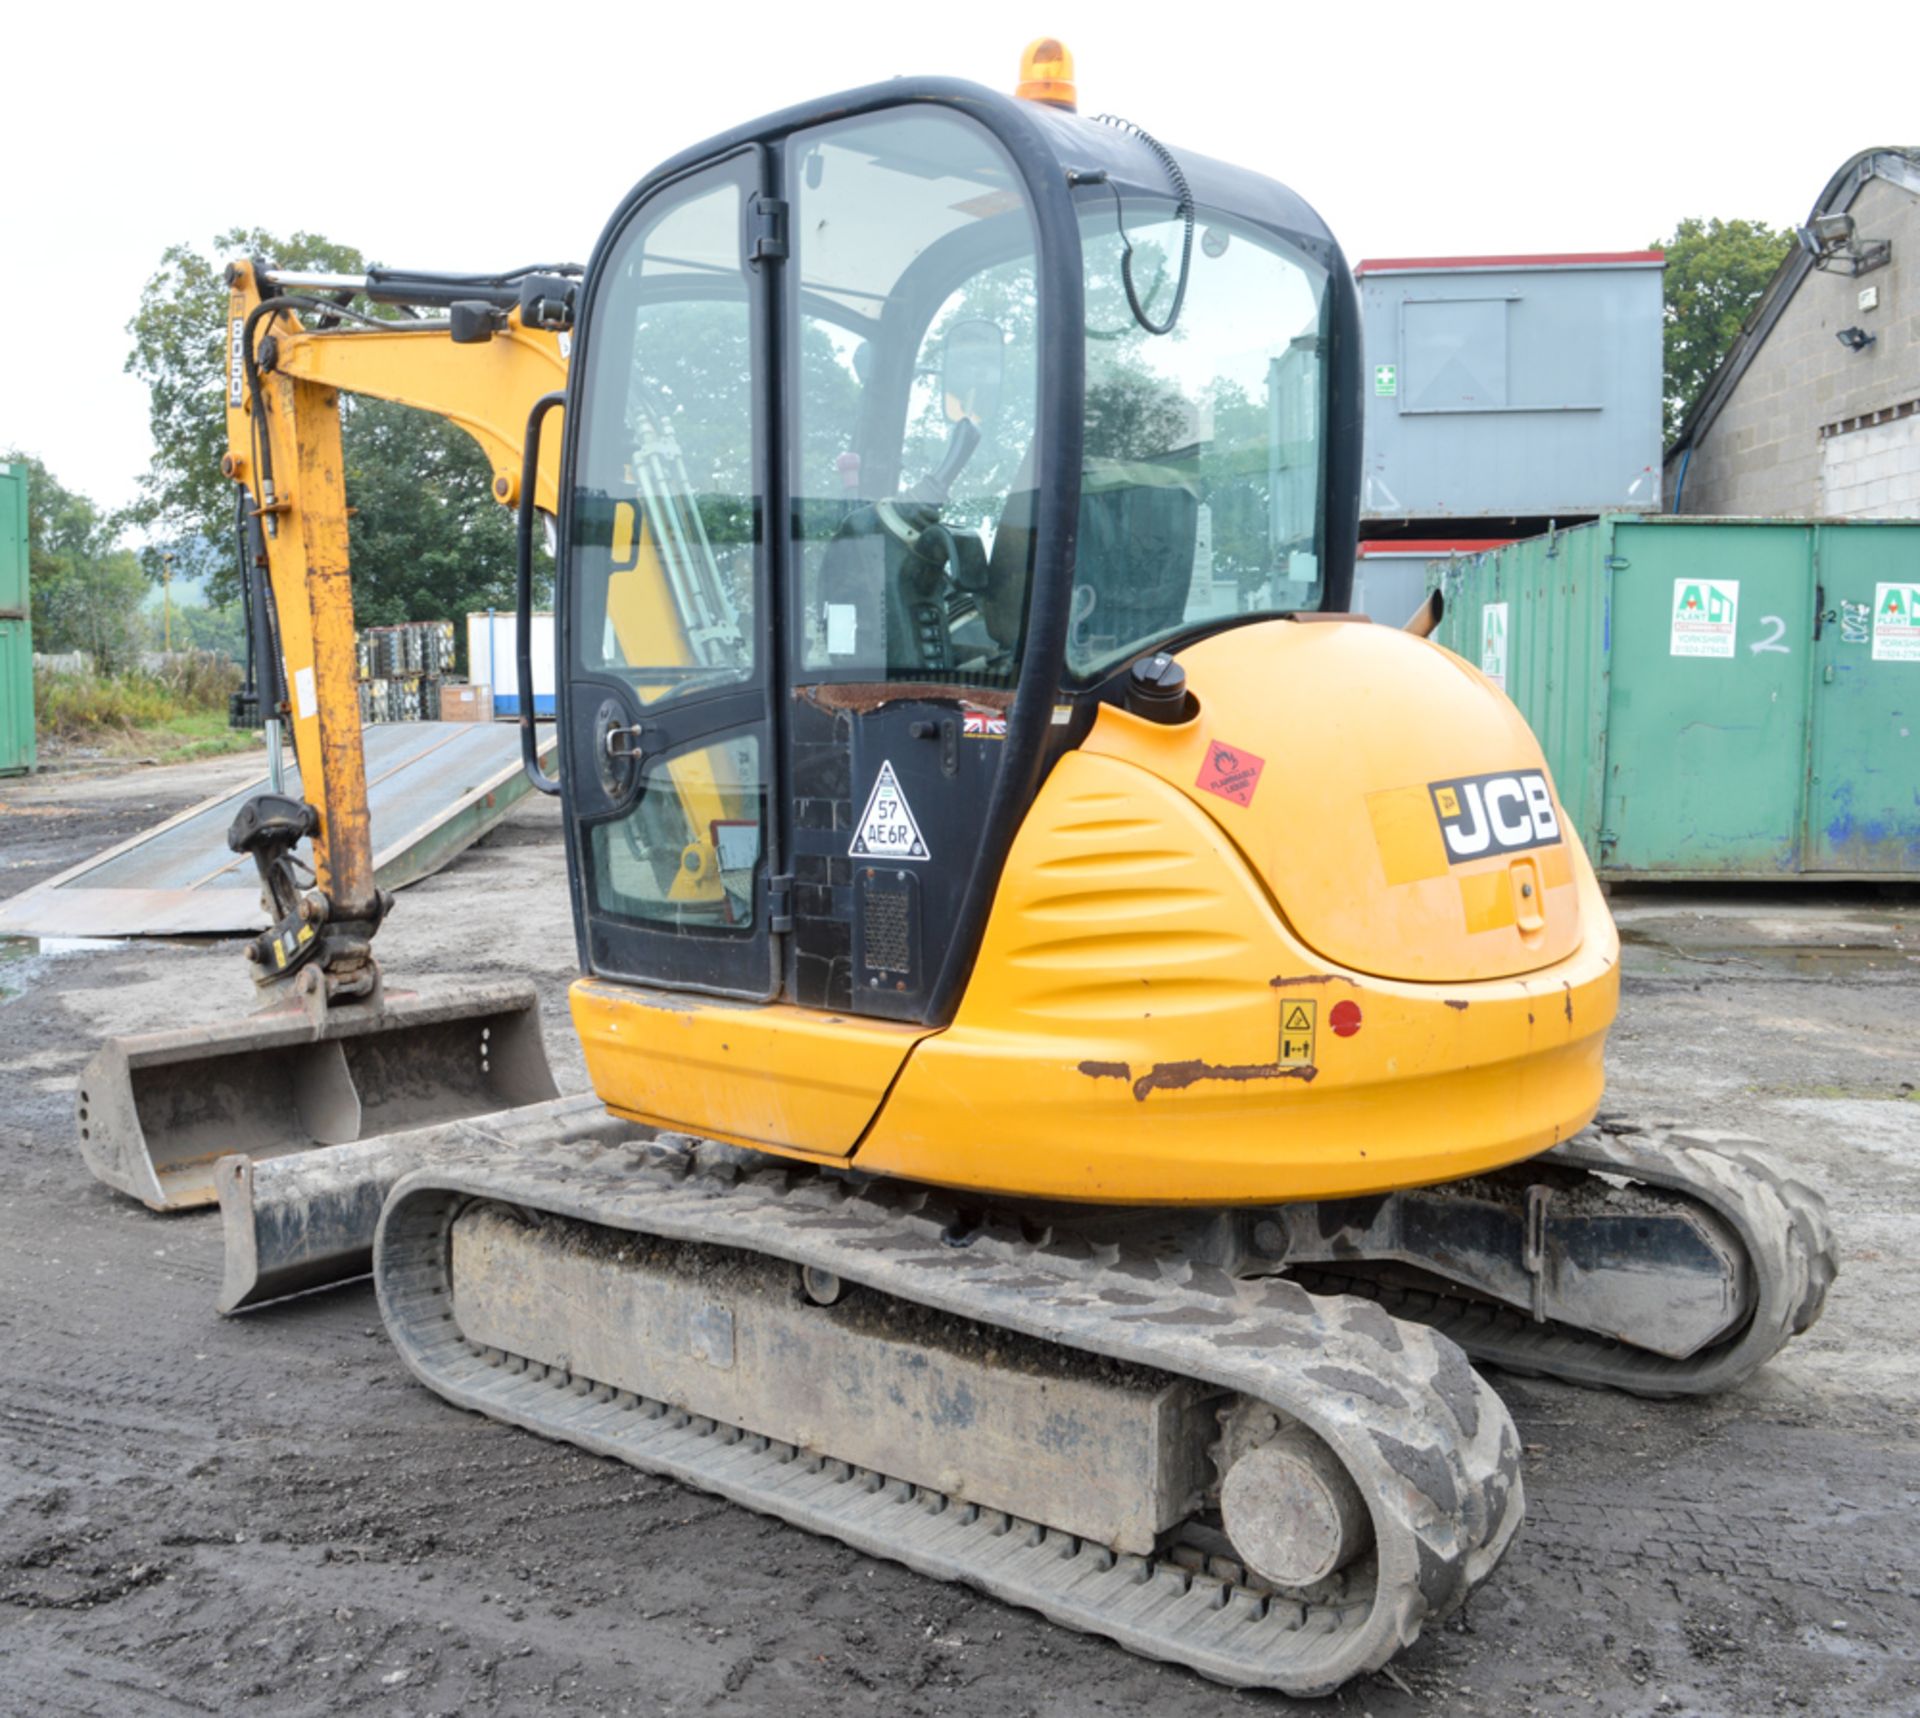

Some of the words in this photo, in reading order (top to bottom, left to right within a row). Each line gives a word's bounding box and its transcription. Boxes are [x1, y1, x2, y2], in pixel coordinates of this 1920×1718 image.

[231, 319, 243, 395] 8050
[1676, 612, 1706, 621] PLANT
[1677, 635, 1728, 644] YORKSHIRE
[1749, 615, 1790, 656] 2
[1211, 768, 1256, 789] FLAMMABLE
[1225, 780, 1250, 794] LIQUID
[878, 800, 898, 820] 57
[1445, 775, 1559, 854] JCB
[867, 824, 908, 844] AE6R
